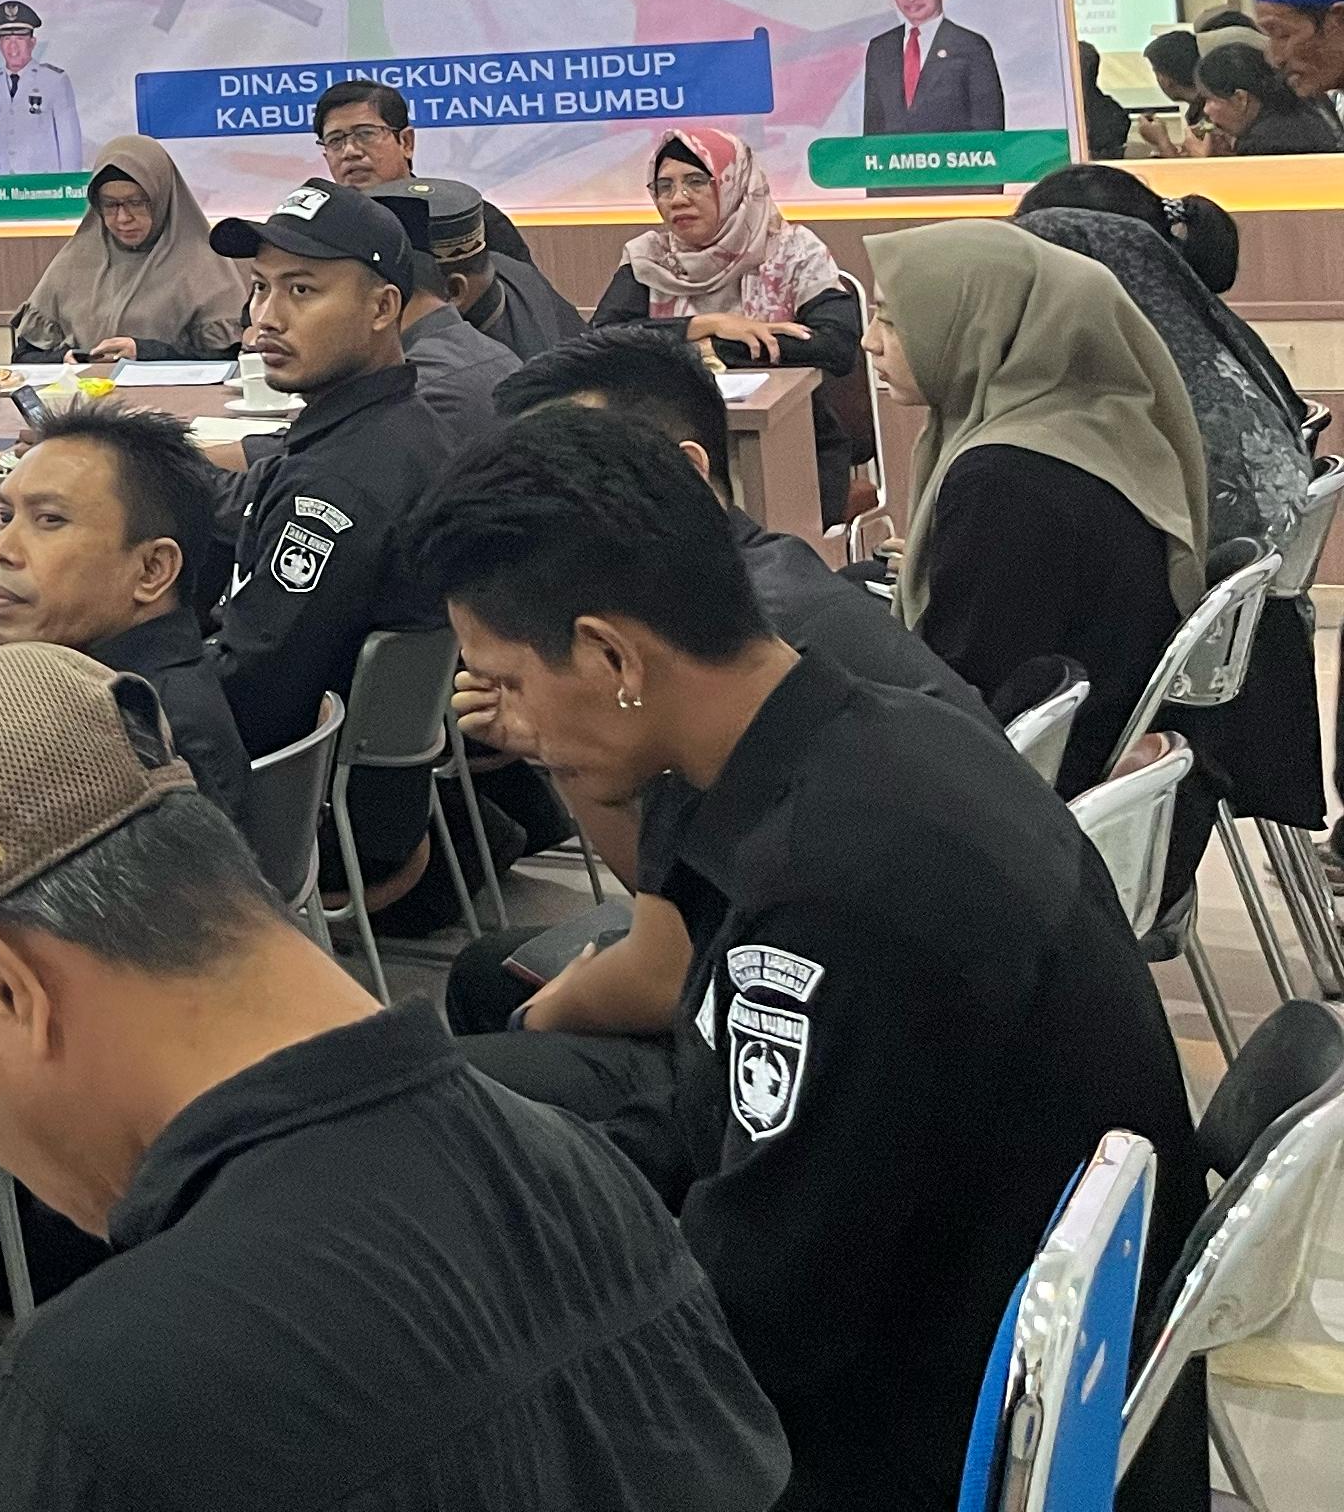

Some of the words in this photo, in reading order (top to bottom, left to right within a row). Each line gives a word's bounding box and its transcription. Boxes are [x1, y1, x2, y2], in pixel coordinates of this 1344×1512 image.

[219, 70, 317, 97] DINAS
[565, 52, 676, 80] HIDUP
[423, 93, 544, 121] TANAH
[554, 87, 685, 115] BUMBU
[865, 155, 883, 170] H.
[888, 153, 941, 170] AMBO
[946, 151, 997, 168] SAKA
